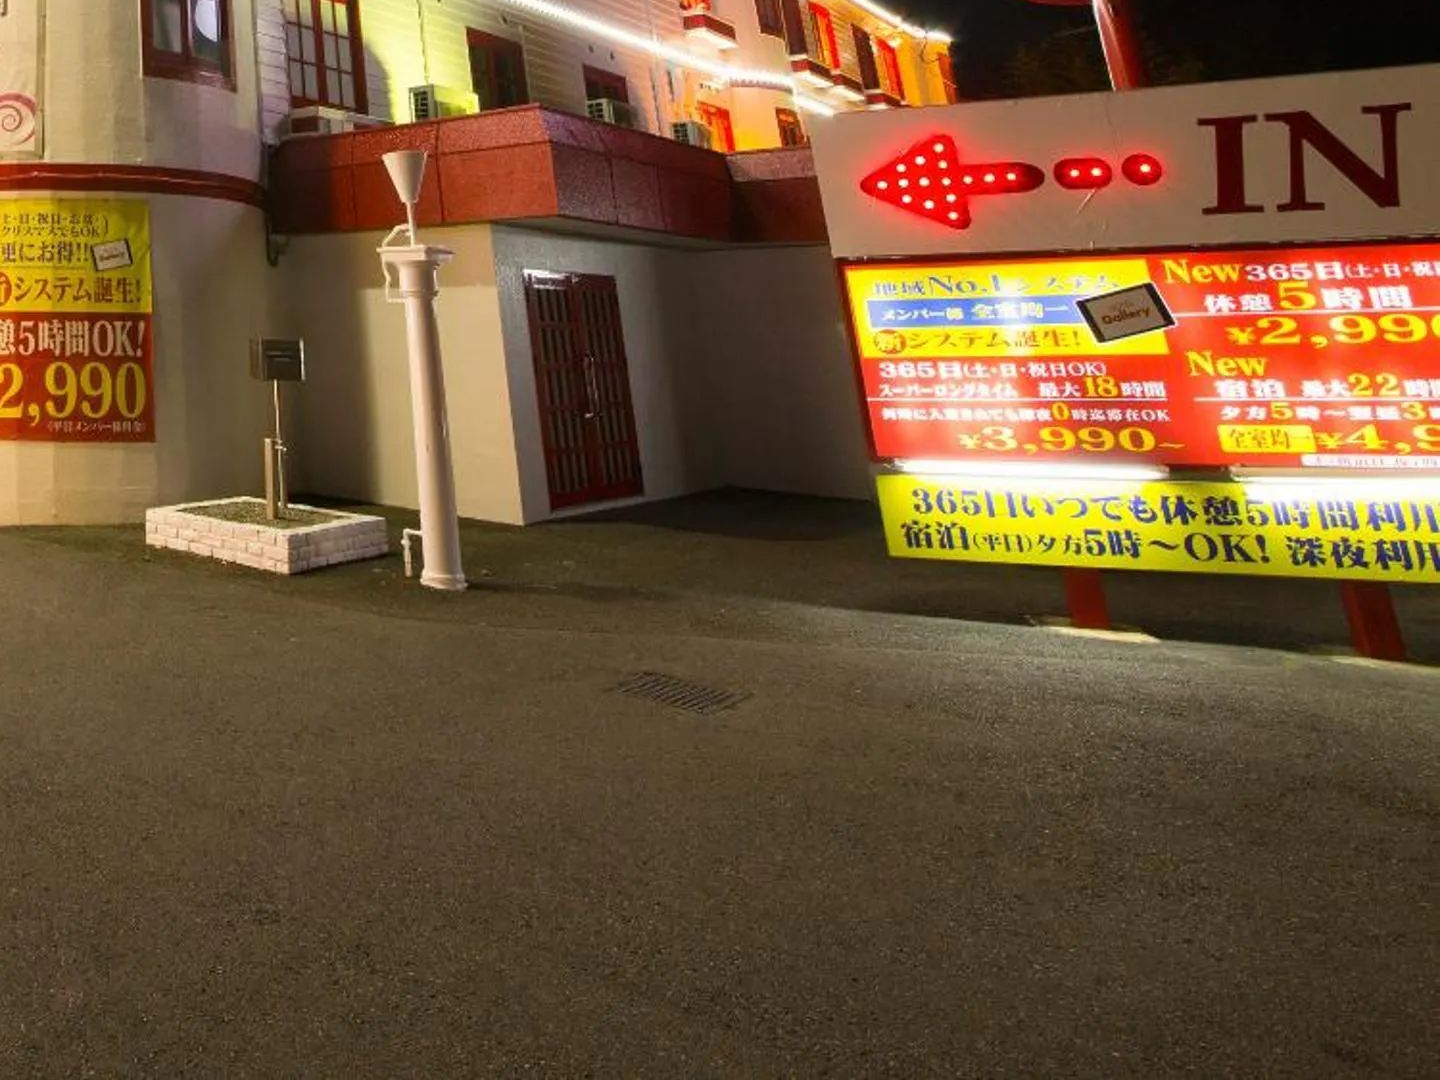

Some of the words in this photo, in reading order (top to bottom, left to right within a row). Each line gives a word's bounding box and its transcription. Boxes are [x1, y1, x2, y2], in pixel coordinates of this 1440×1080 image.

[1197, 102, 1412, 215] IN
[1162, 259, 1242, 284] New
[1225, 314, 1440, 348] ¥2,99
[1185, 350, 1267, 376] New
